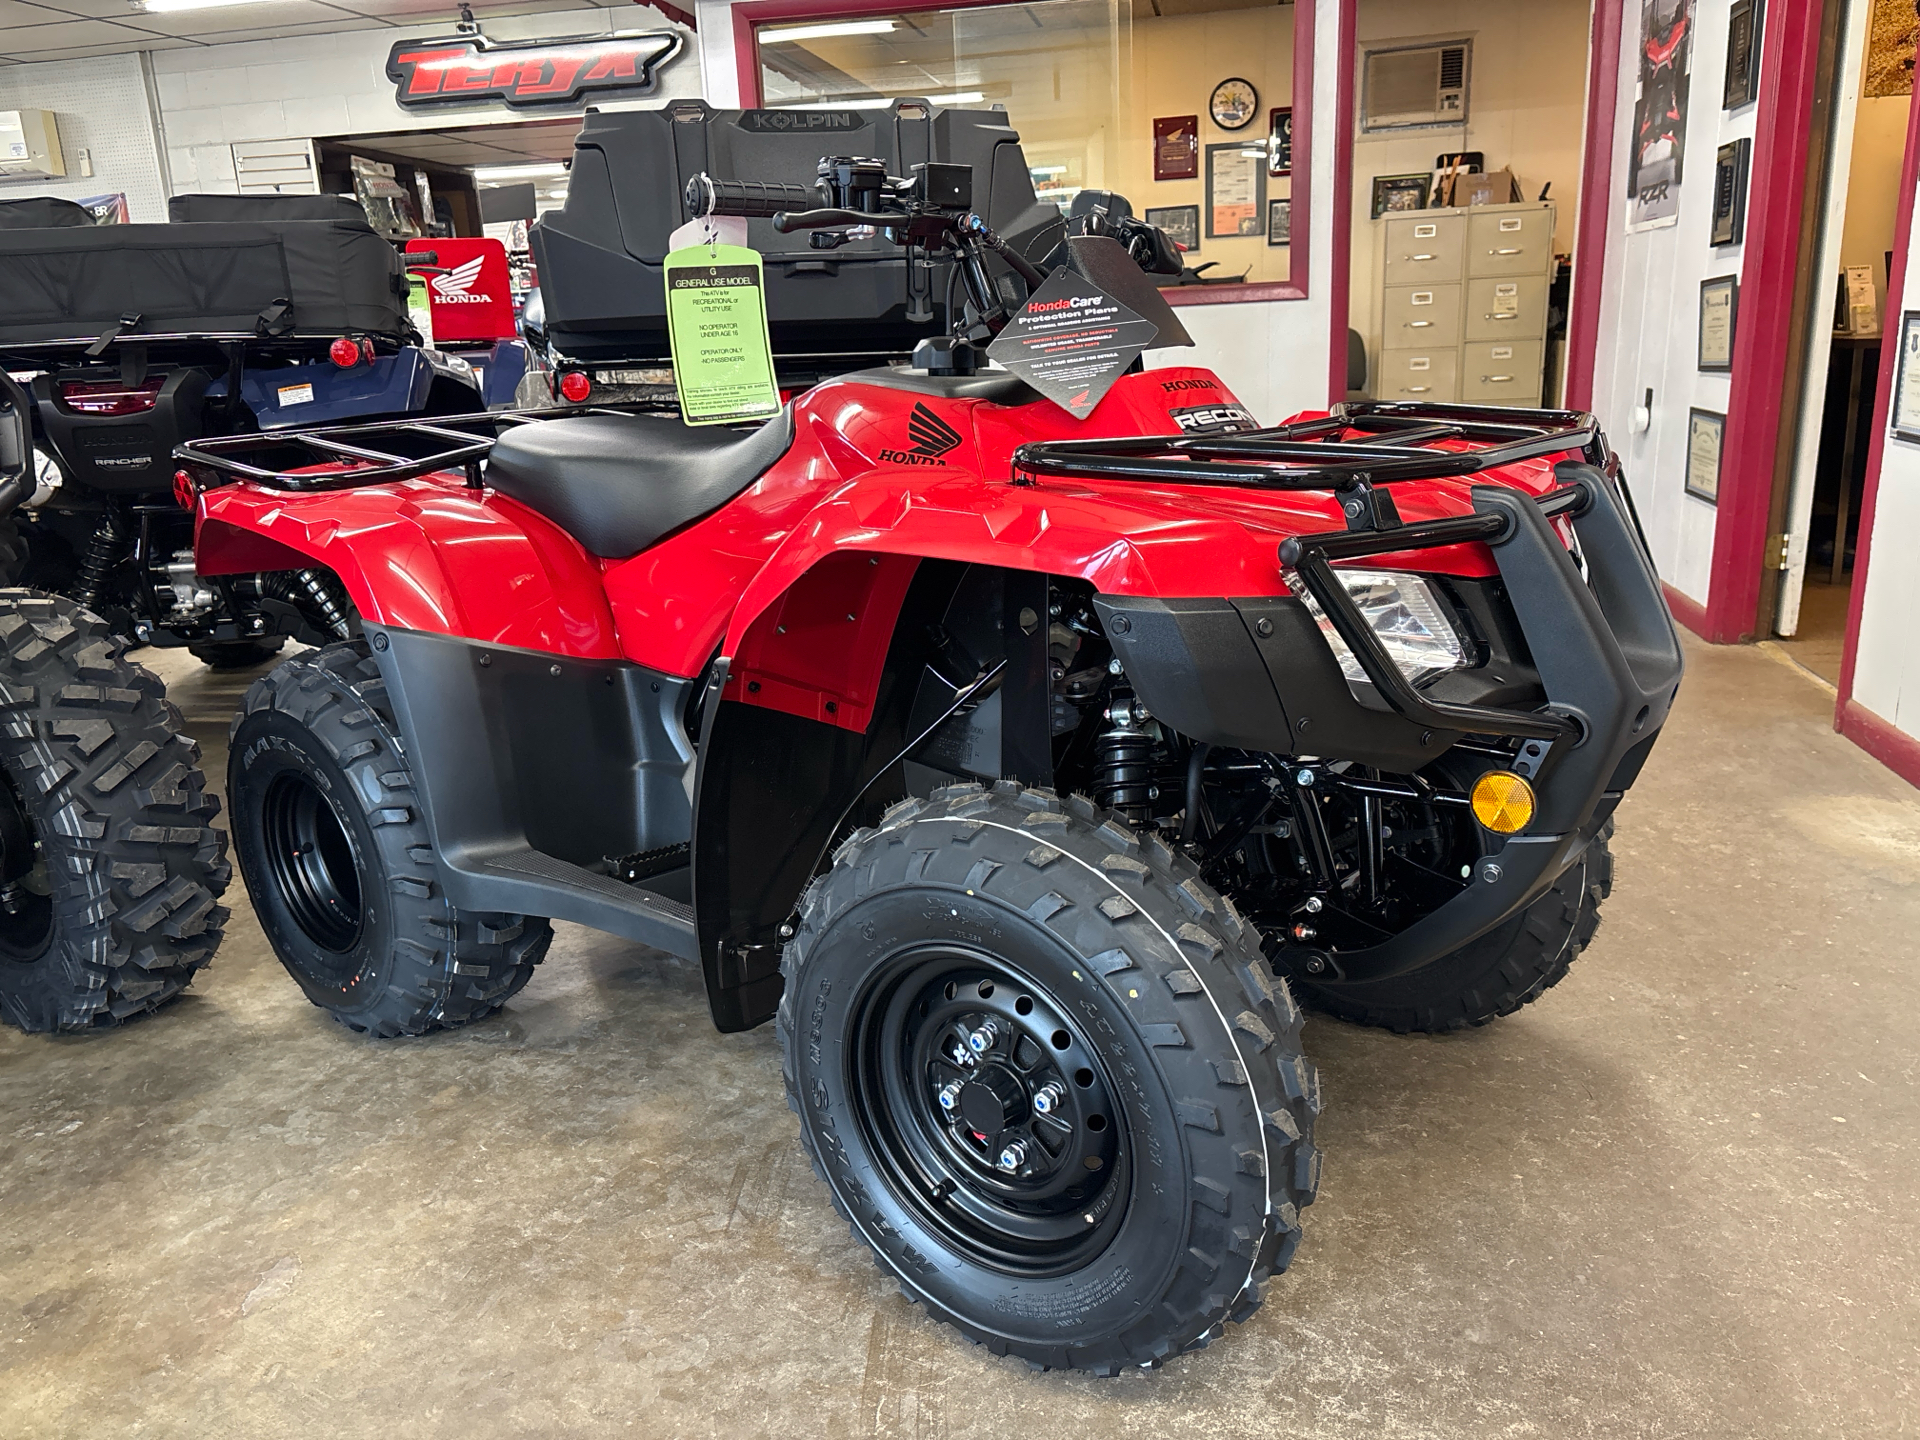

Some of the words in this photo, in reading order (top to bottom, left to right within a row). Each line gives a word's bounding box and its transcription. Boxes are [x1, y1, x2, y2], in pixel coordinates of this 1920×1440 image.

[397, 50, 641, 96] TERYX
[752, 112, 851, 129] KOLPIN
[1637, 179, 1669, 209] RZR
[709, 267, 717, 276] G
[675, 278, 710, 288] GENERAL
[710, 278, 726, 286] USE
[726, 276, 753, 286] MODEL
[433, 294, 493, 304] HONDA
[692, 298, 734, 306] RECREATIONAL
[1028, 296, 1104, 314] HondaCare
[1018, 310, 1082, 325] Protection
[1084, 306, 1119, 316] Plans
[708, 323, 738, 331] OPERATOR
[700, 348, 730, 356] OPERATOR
[711, 356, 746, 364] PASSENGERS
[1066, 356, 1086, 364] DEALER
[1160, 379, 1219, 393] HONDA
[1173, 409, 1255, 429] RECON
[94, 456, 152, 466] RANCHER
[811, 1075, 940, 1276] MAXXIS
